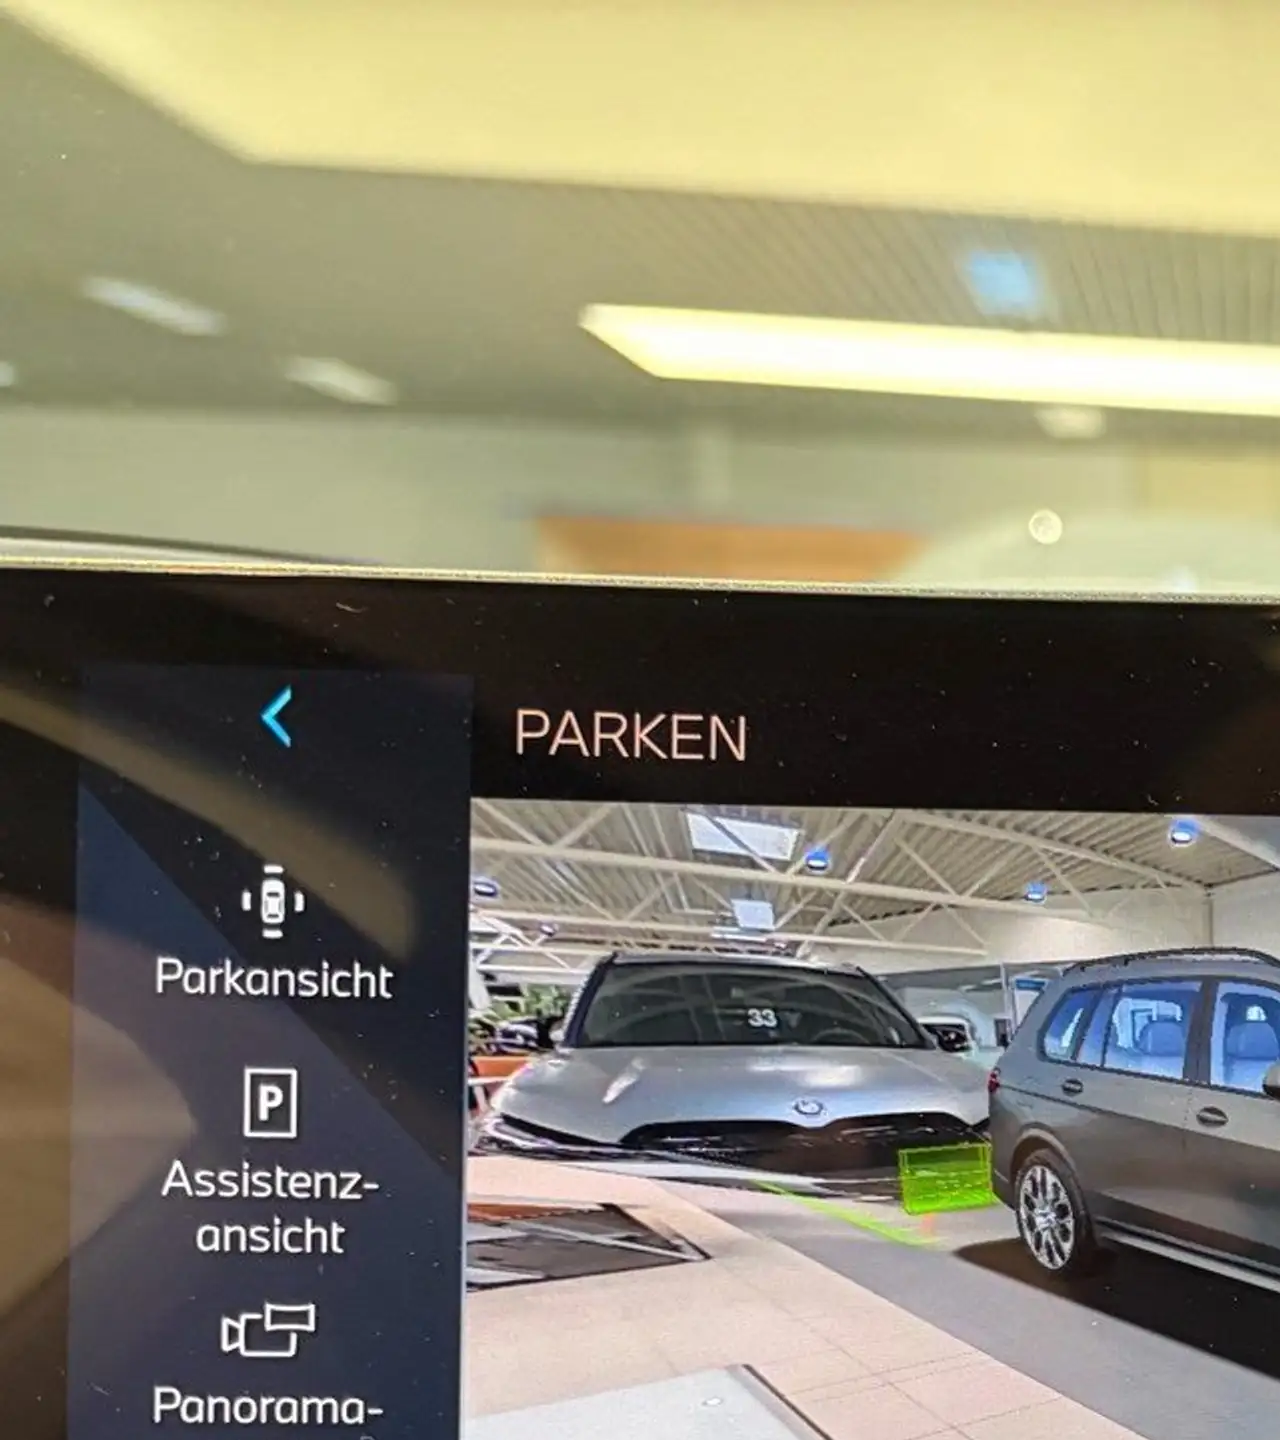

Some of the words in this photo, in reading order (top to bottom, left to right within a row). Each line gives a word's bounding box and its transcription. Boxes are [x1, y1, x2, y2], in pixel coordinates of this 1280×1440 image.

[517, 708, 746, 761] PARKEN
[155, 955, 394, 999] Parkansicht
[747, 1008, 777, 1027] 33
[160, 1158, 380, 1200] Assistenz-
[195, 1215, 346, 1254] ansicht
[153, 1385, 384, 1425] Panorama-
